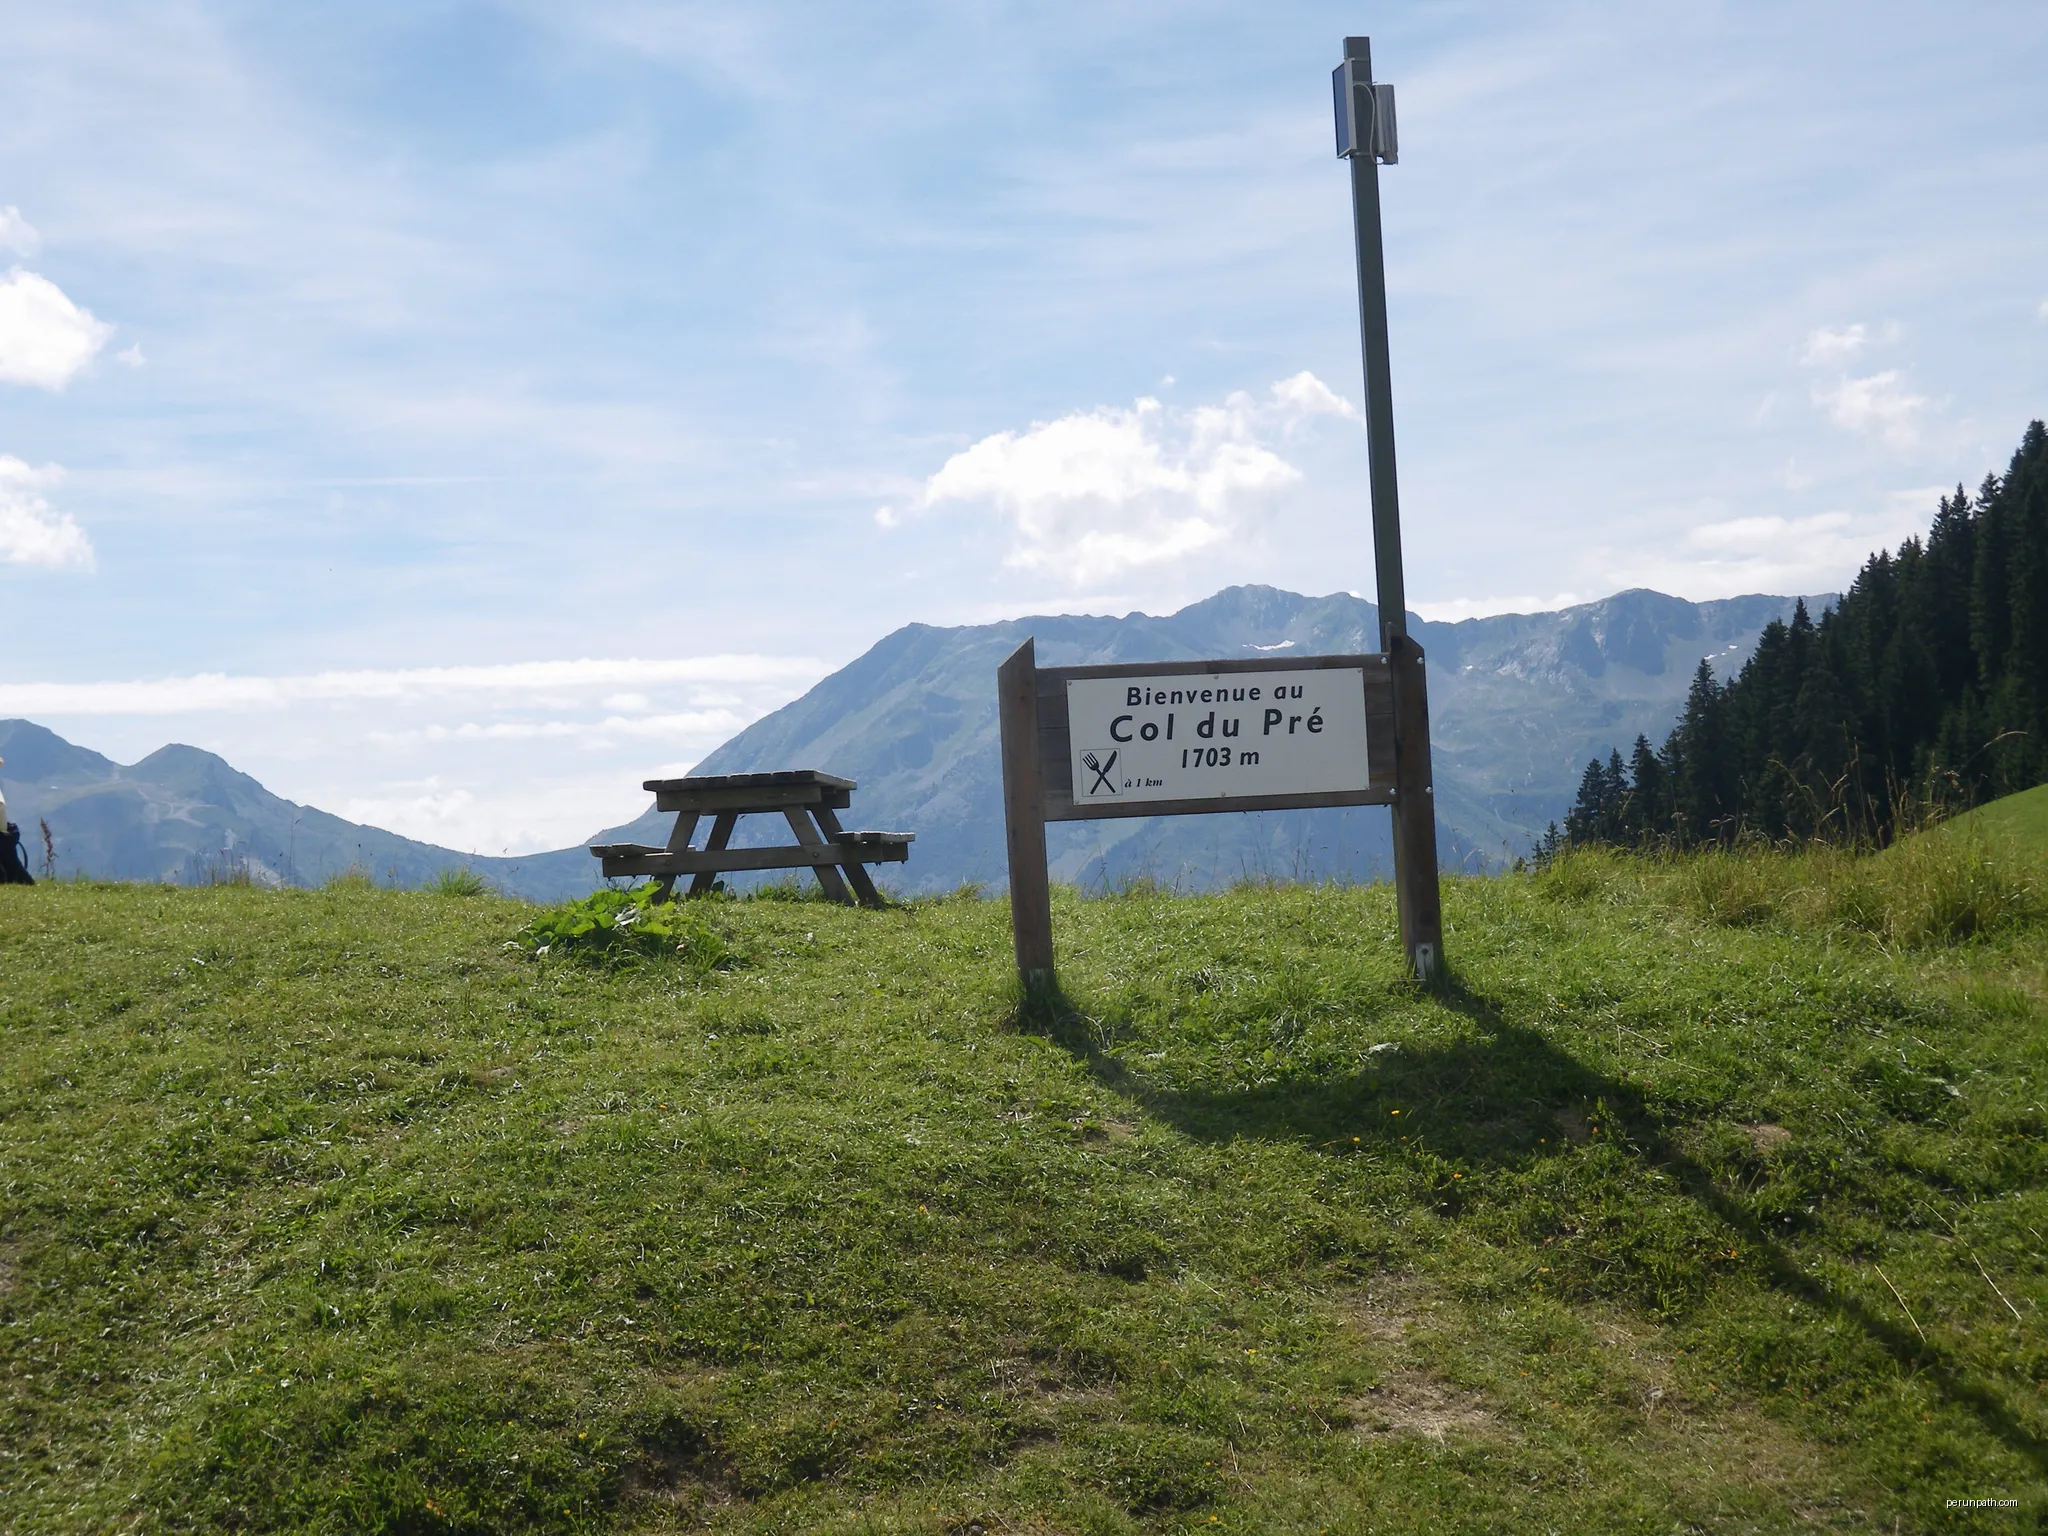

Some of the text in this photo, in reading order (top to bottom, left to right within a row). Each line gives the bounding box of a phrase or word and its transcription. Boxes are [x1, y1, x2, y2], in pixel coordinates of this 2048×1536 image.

[1126, 685, 1303, 706] Bienvenue au
[1109, 706, 1324, 743] Col du Pré
[1181, 747, 1260, 768] 1703 m
[1124, 777, 1163, 788] à 1 km
